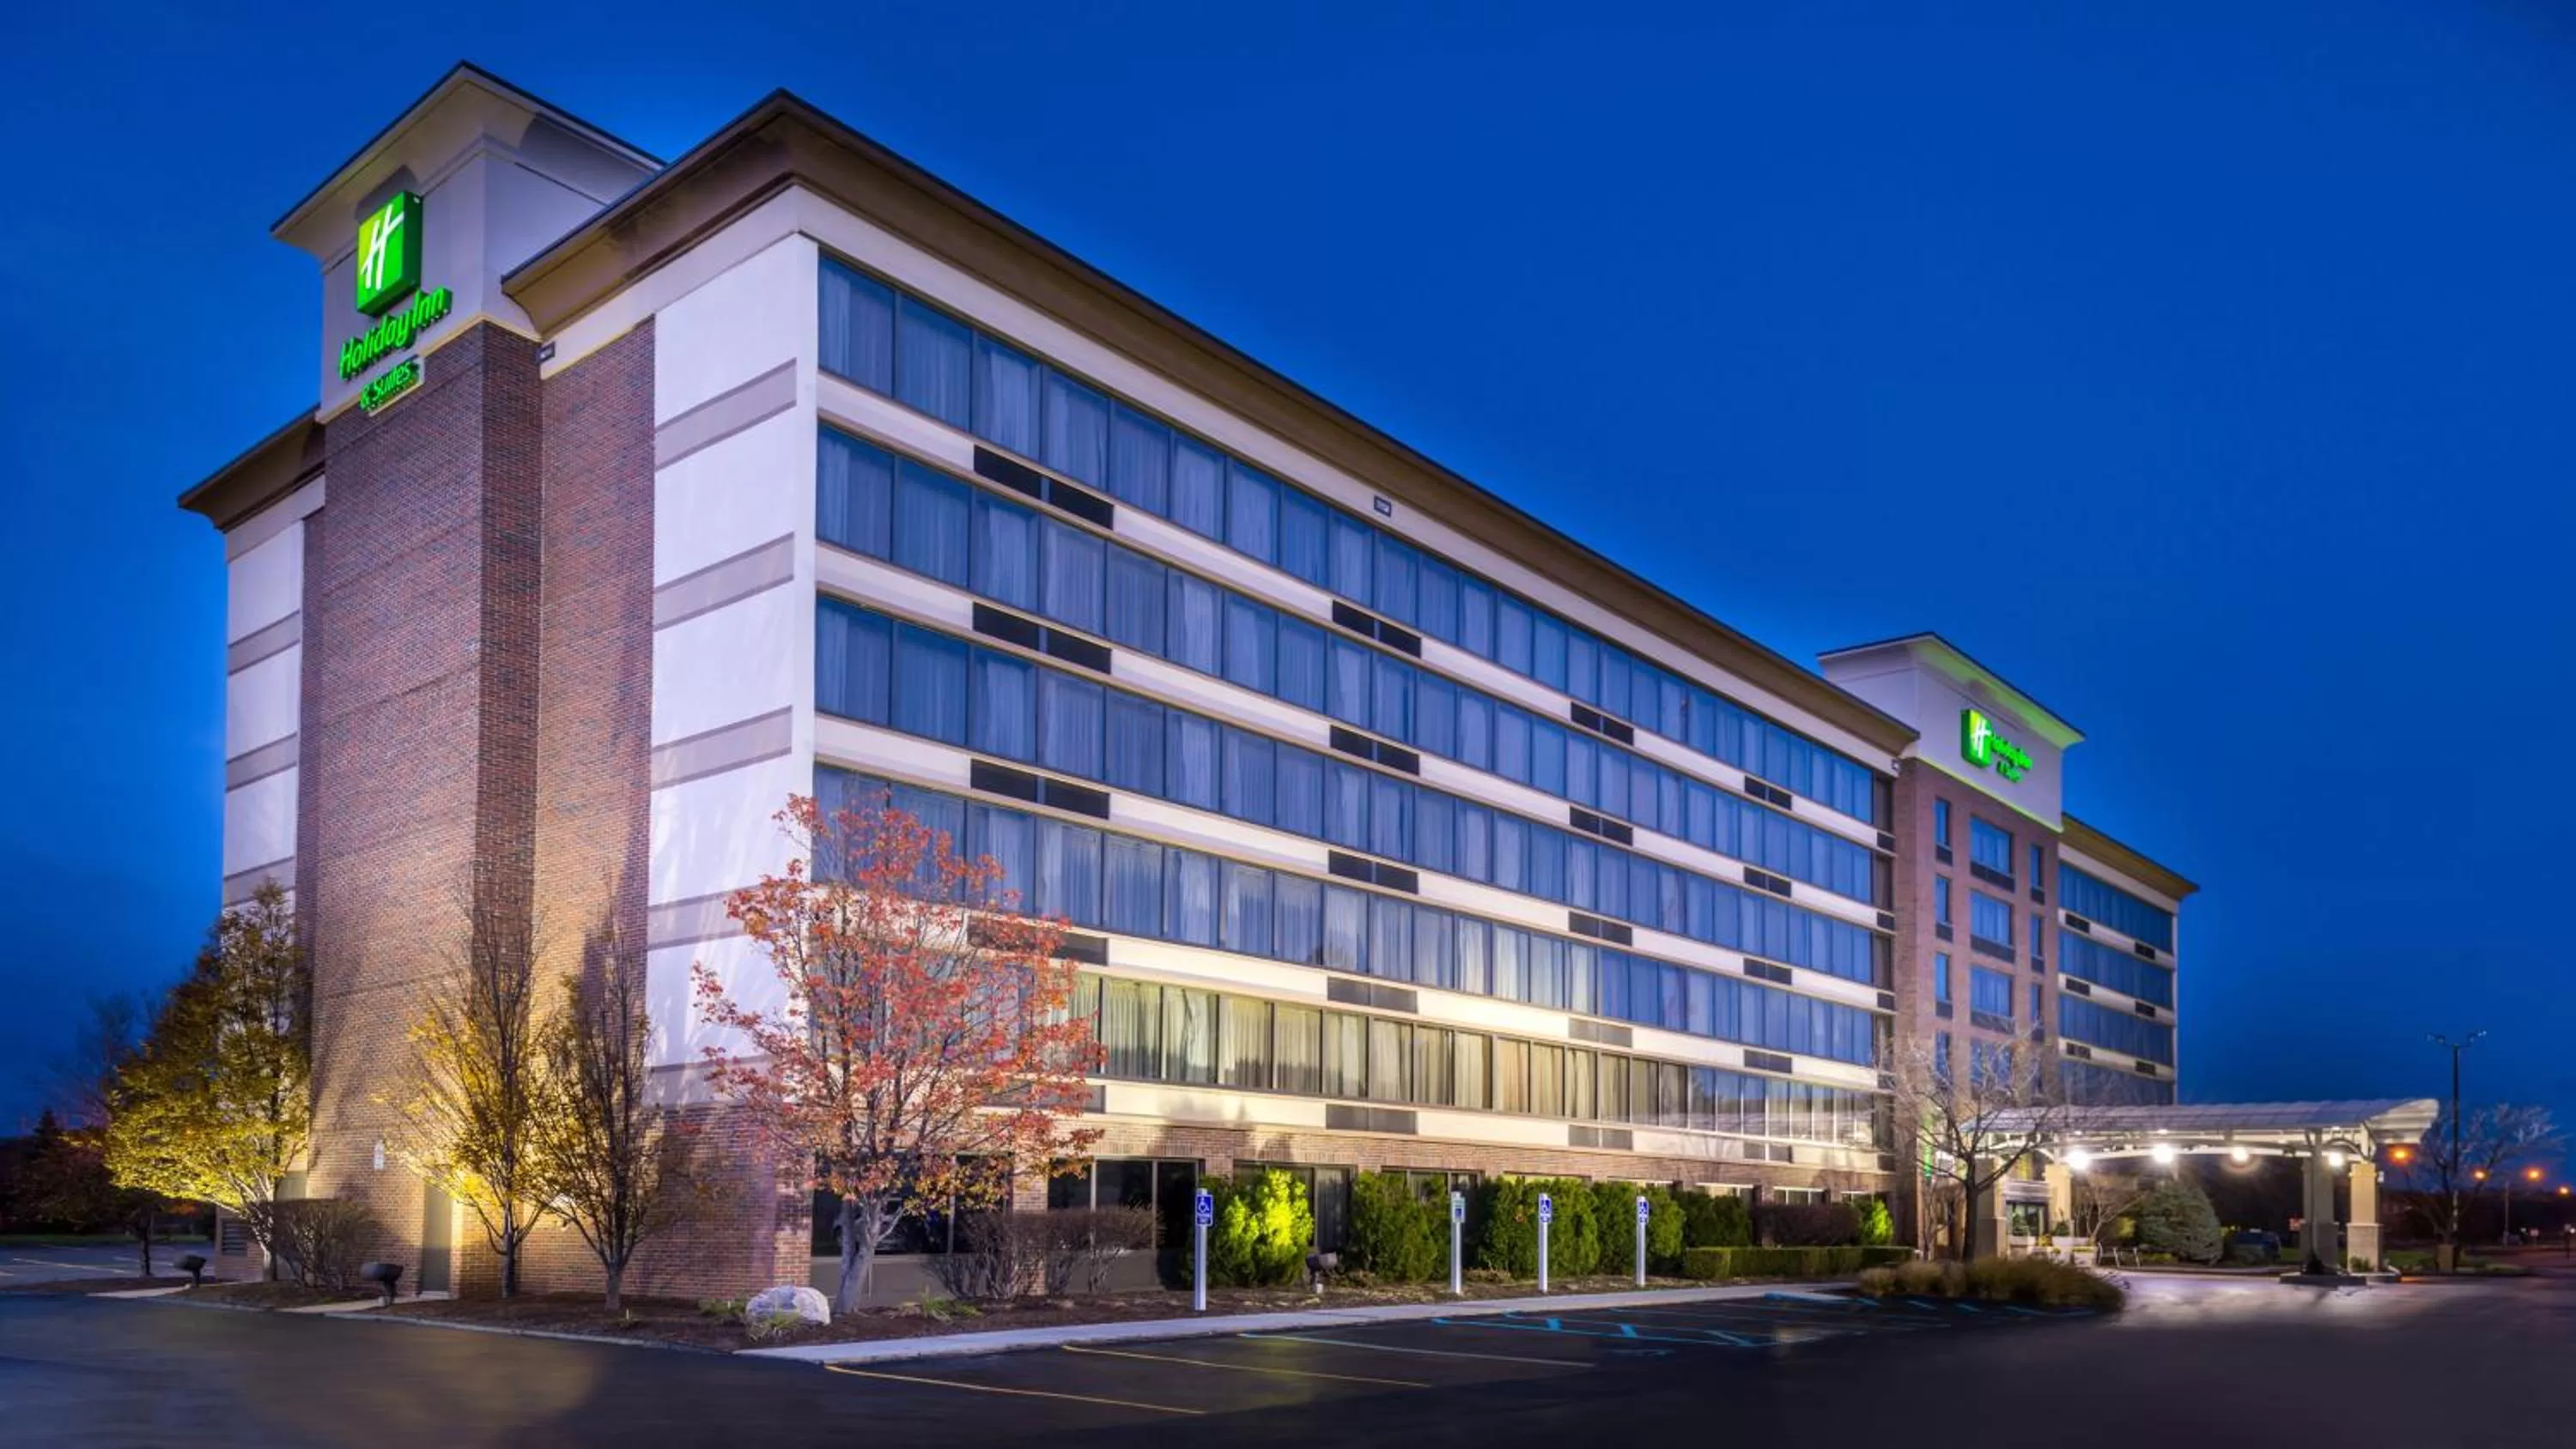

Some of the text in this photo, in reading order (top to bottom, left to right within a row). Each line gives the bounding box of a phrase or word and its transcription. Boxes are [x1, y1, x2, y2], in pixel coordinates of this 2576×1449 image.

[361, 203, 404, 290] H
[338, 288, 447, 379] Holiday Inn
[374, 361, 413, 397] Suites
